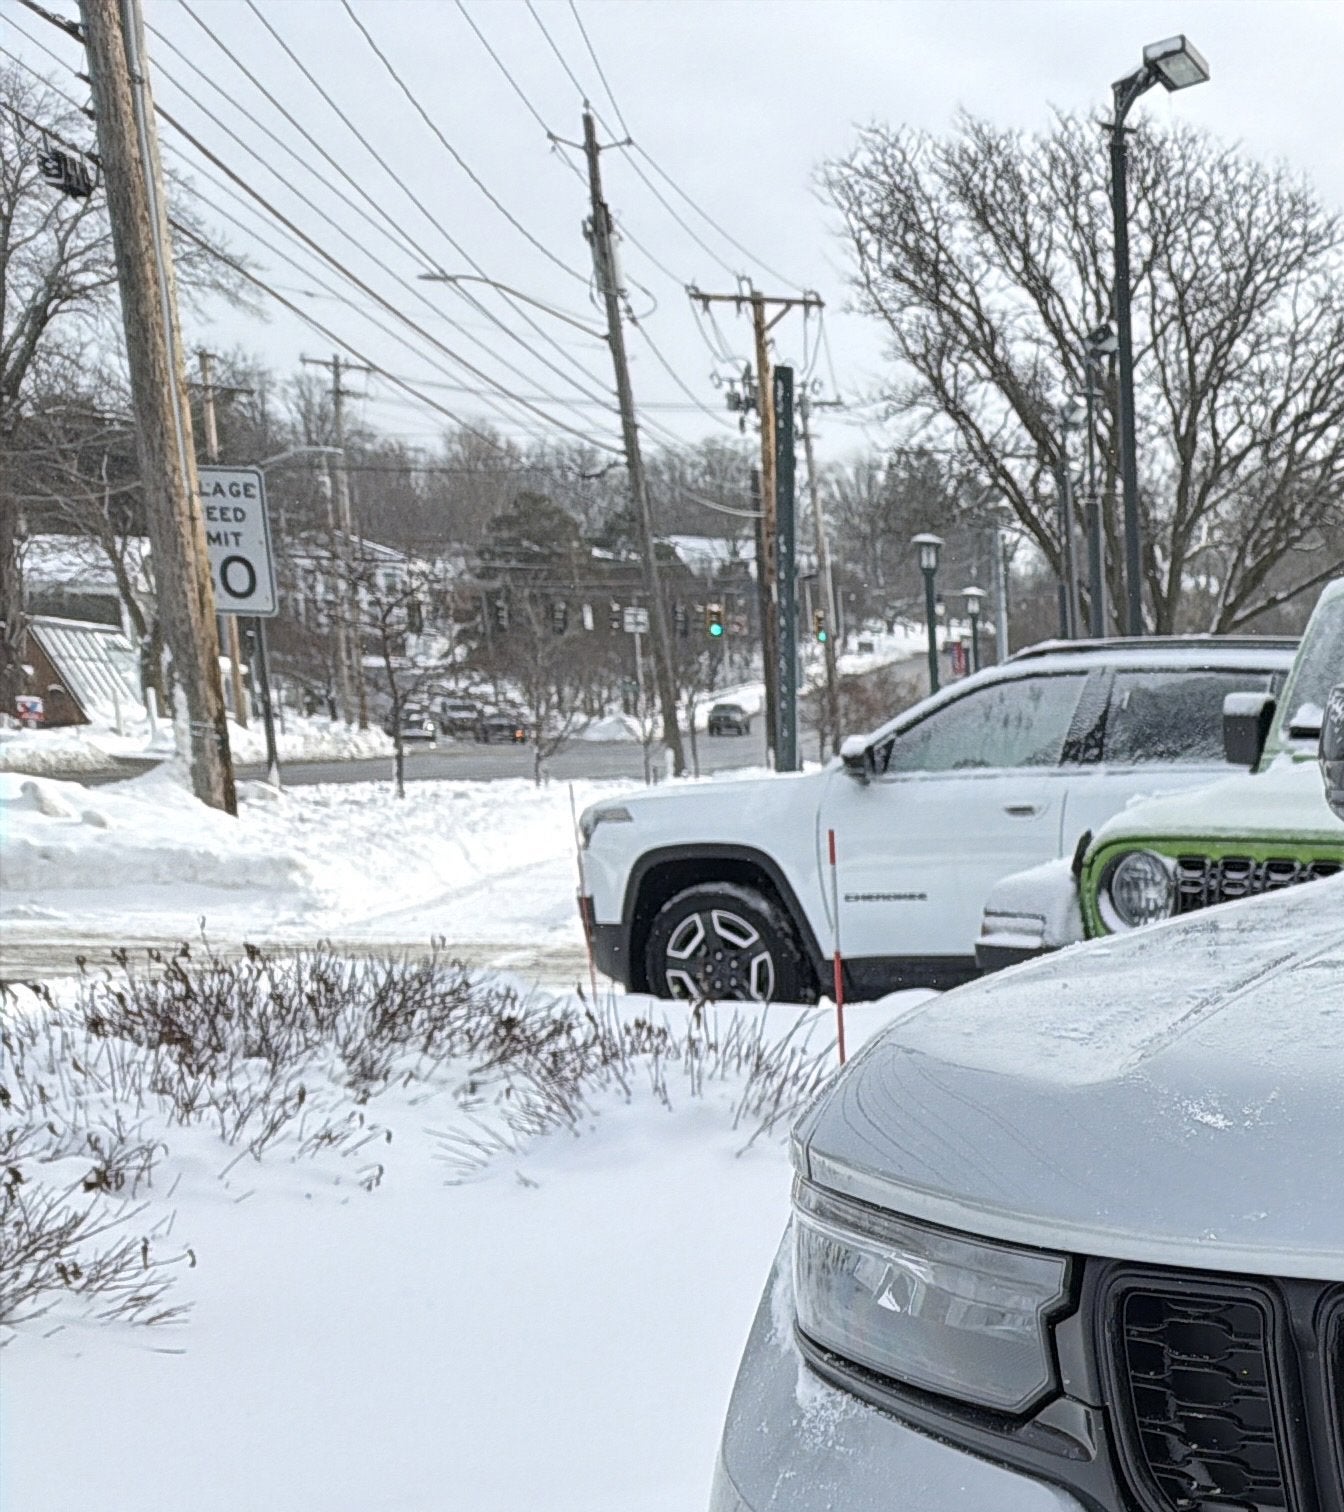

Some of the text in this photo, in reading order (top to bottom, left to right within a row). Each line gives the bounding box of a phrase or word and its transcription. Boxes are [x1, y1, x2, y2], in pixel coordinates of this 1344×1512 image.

[199, 481, 256, 498] LAGE
[206, 506, 247, 522] EED
[206, 531, 242, 547] MIT
[219, 555, 257, 599] 0
